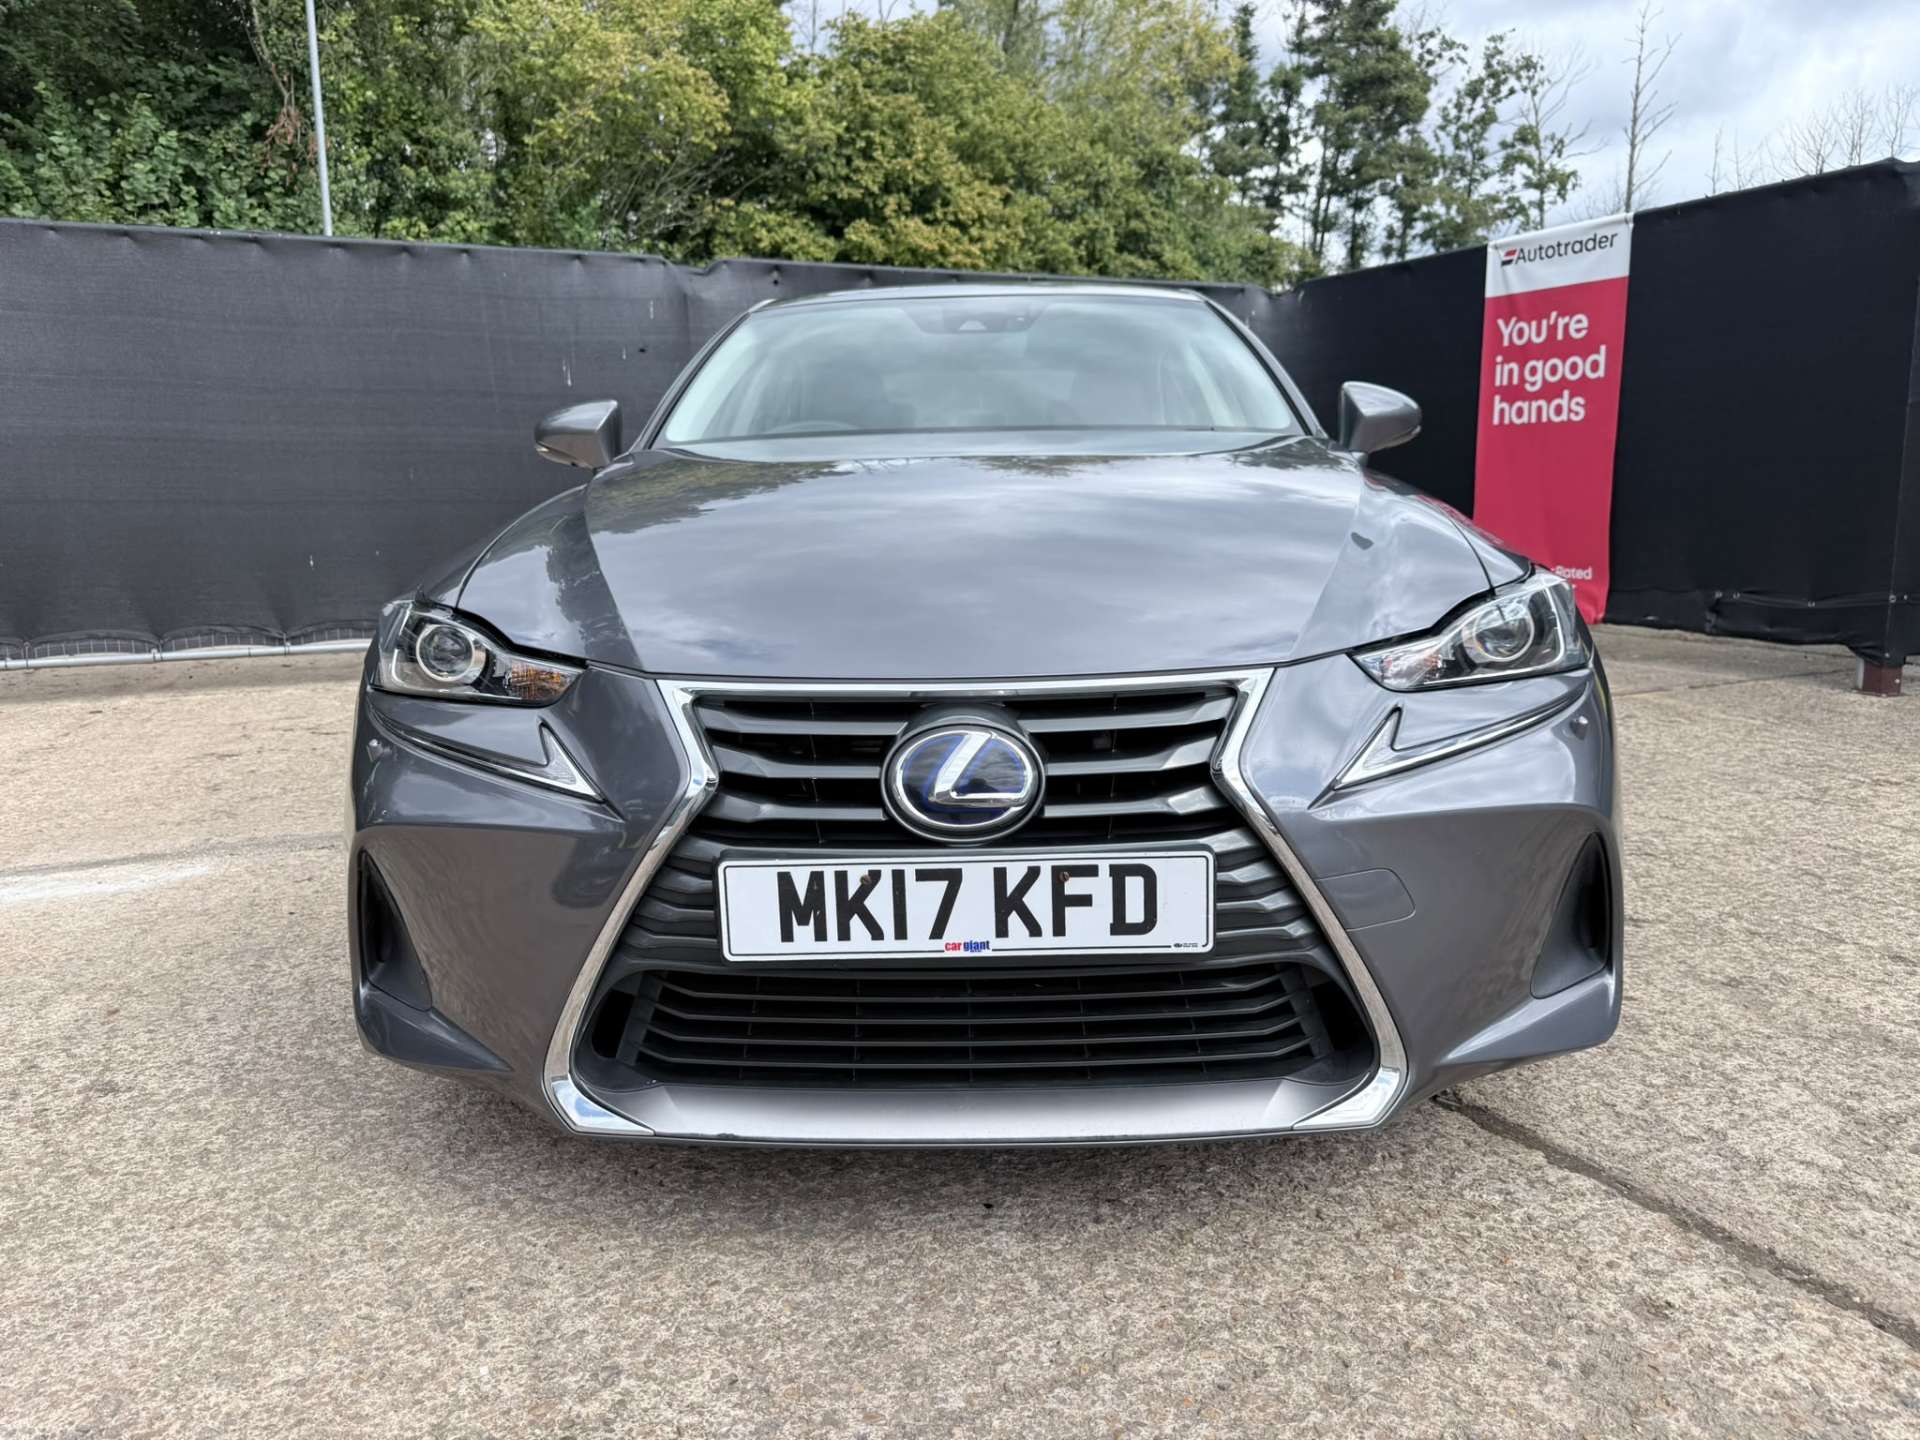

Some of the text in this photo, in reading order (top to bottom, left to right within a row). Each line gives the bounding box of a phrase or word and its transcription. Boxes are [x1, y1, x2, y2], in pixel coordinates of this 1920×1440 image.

[1514, 232, 1618, 265] Autotrader
[1497, 311, 1589, 347] You're
[1494, 344, 1607, 392] in good
[1492, 389, 1586, 426] hands
[777, 863, 1158, 943] MK17 KFD
